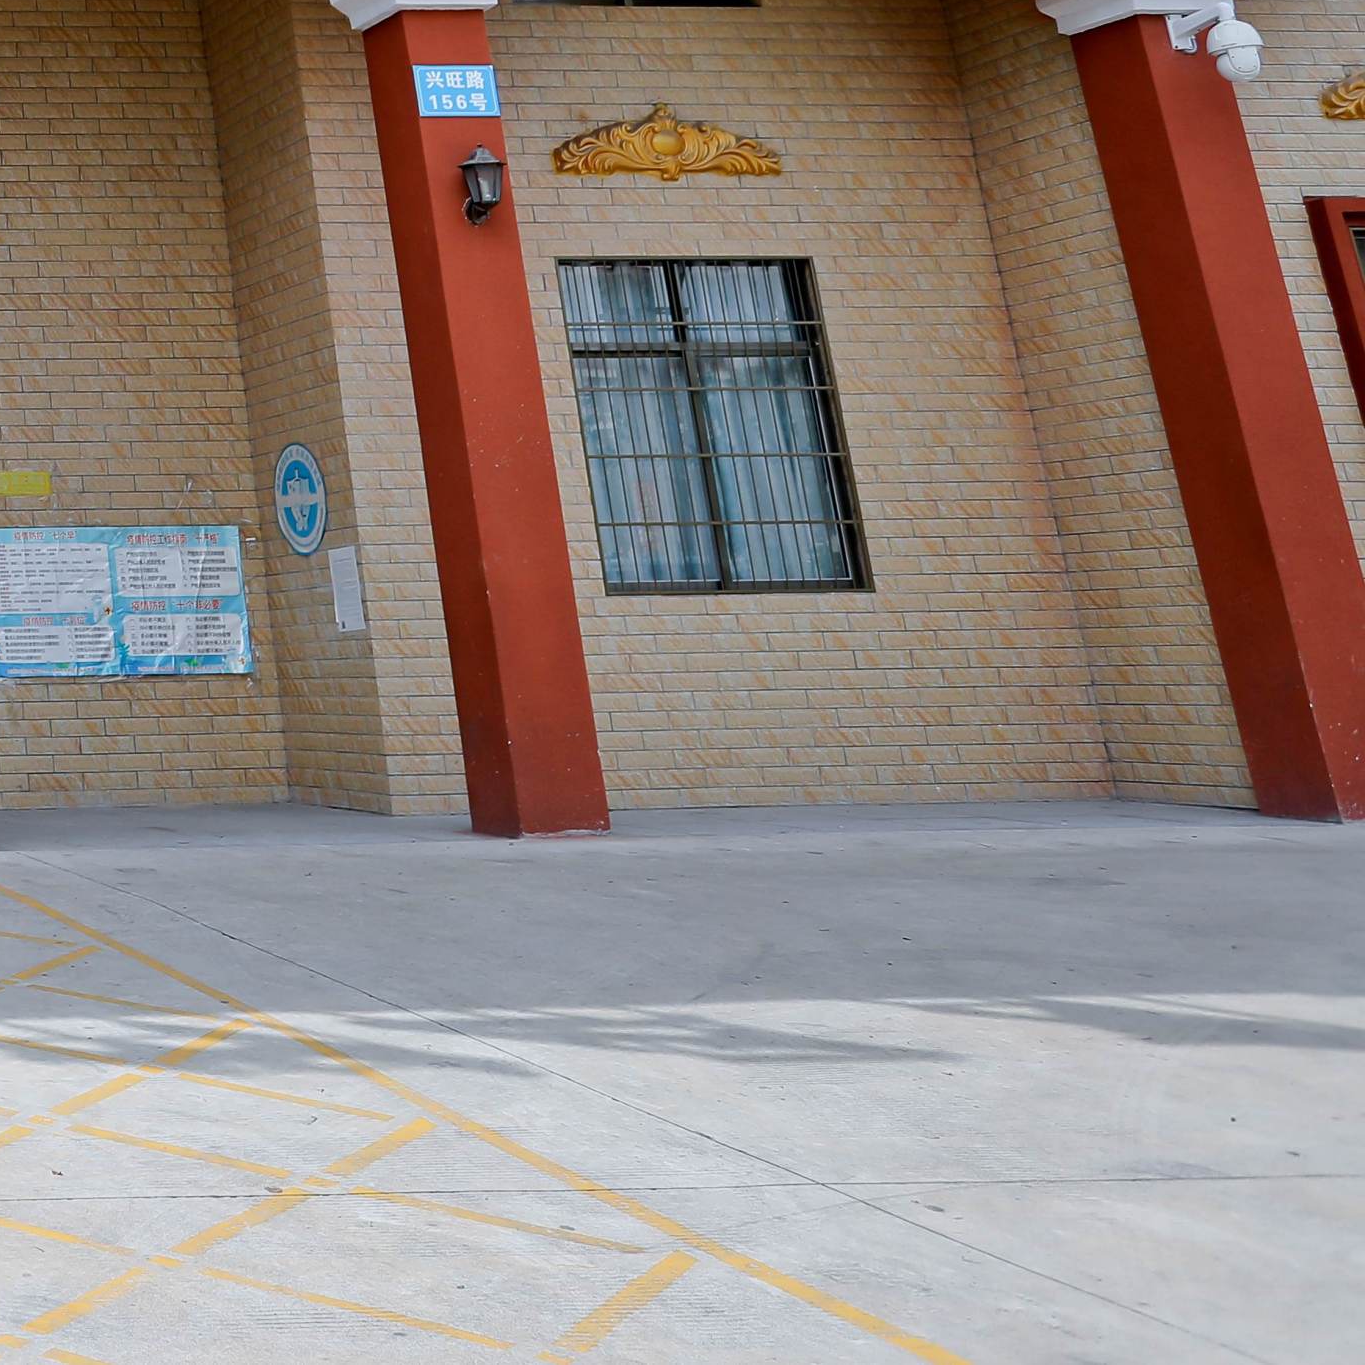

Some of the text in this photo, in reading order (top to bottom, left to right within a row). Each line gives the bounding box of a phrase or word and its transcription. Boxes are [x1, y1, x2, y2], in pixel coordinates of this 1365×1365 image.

[425, 70, 484, 89] 兴旺路
[429, 93, 487, 111] 156号
